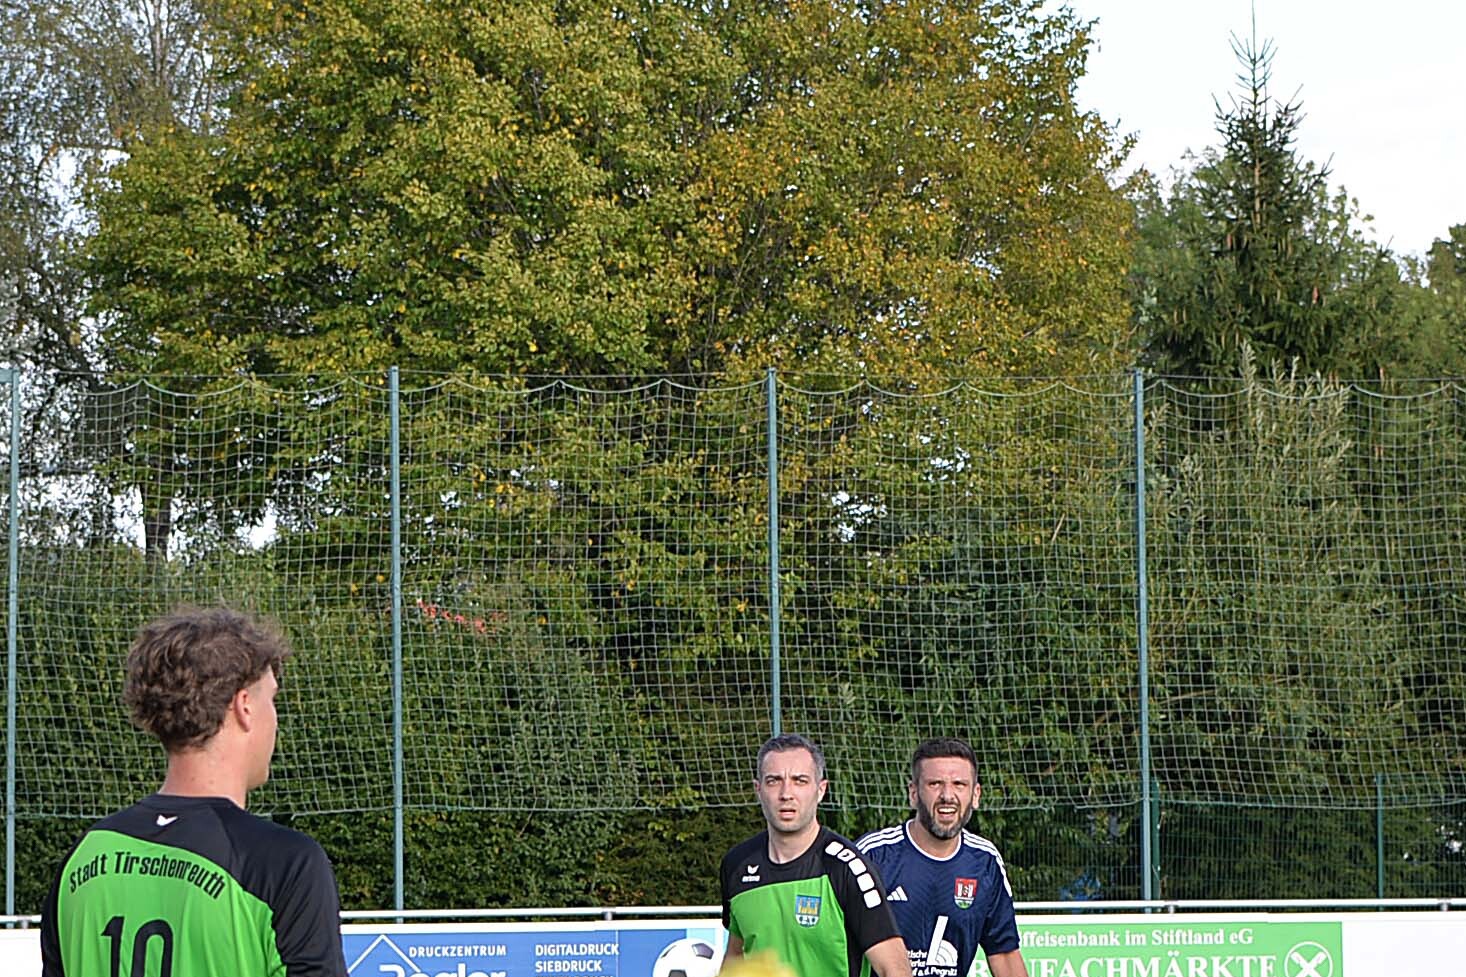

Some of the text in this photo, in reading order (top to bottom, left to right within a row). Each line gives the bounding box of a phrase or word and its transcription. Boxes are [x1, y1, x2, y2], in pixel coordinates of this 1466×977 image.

[114, 851, 226, 900] Tirschenreuth
[1125, 929, 1147, 946] im
[1151, 928, 1225, 946] Stiftland
[1229, 928, 1254, 945] eG
[409, 945, 507, 958] DRUCKZENTRUM
[535, 943, 619, 957] DIGITALDRUCK
[535, 960, 602, 973] SIEBDRUCK
